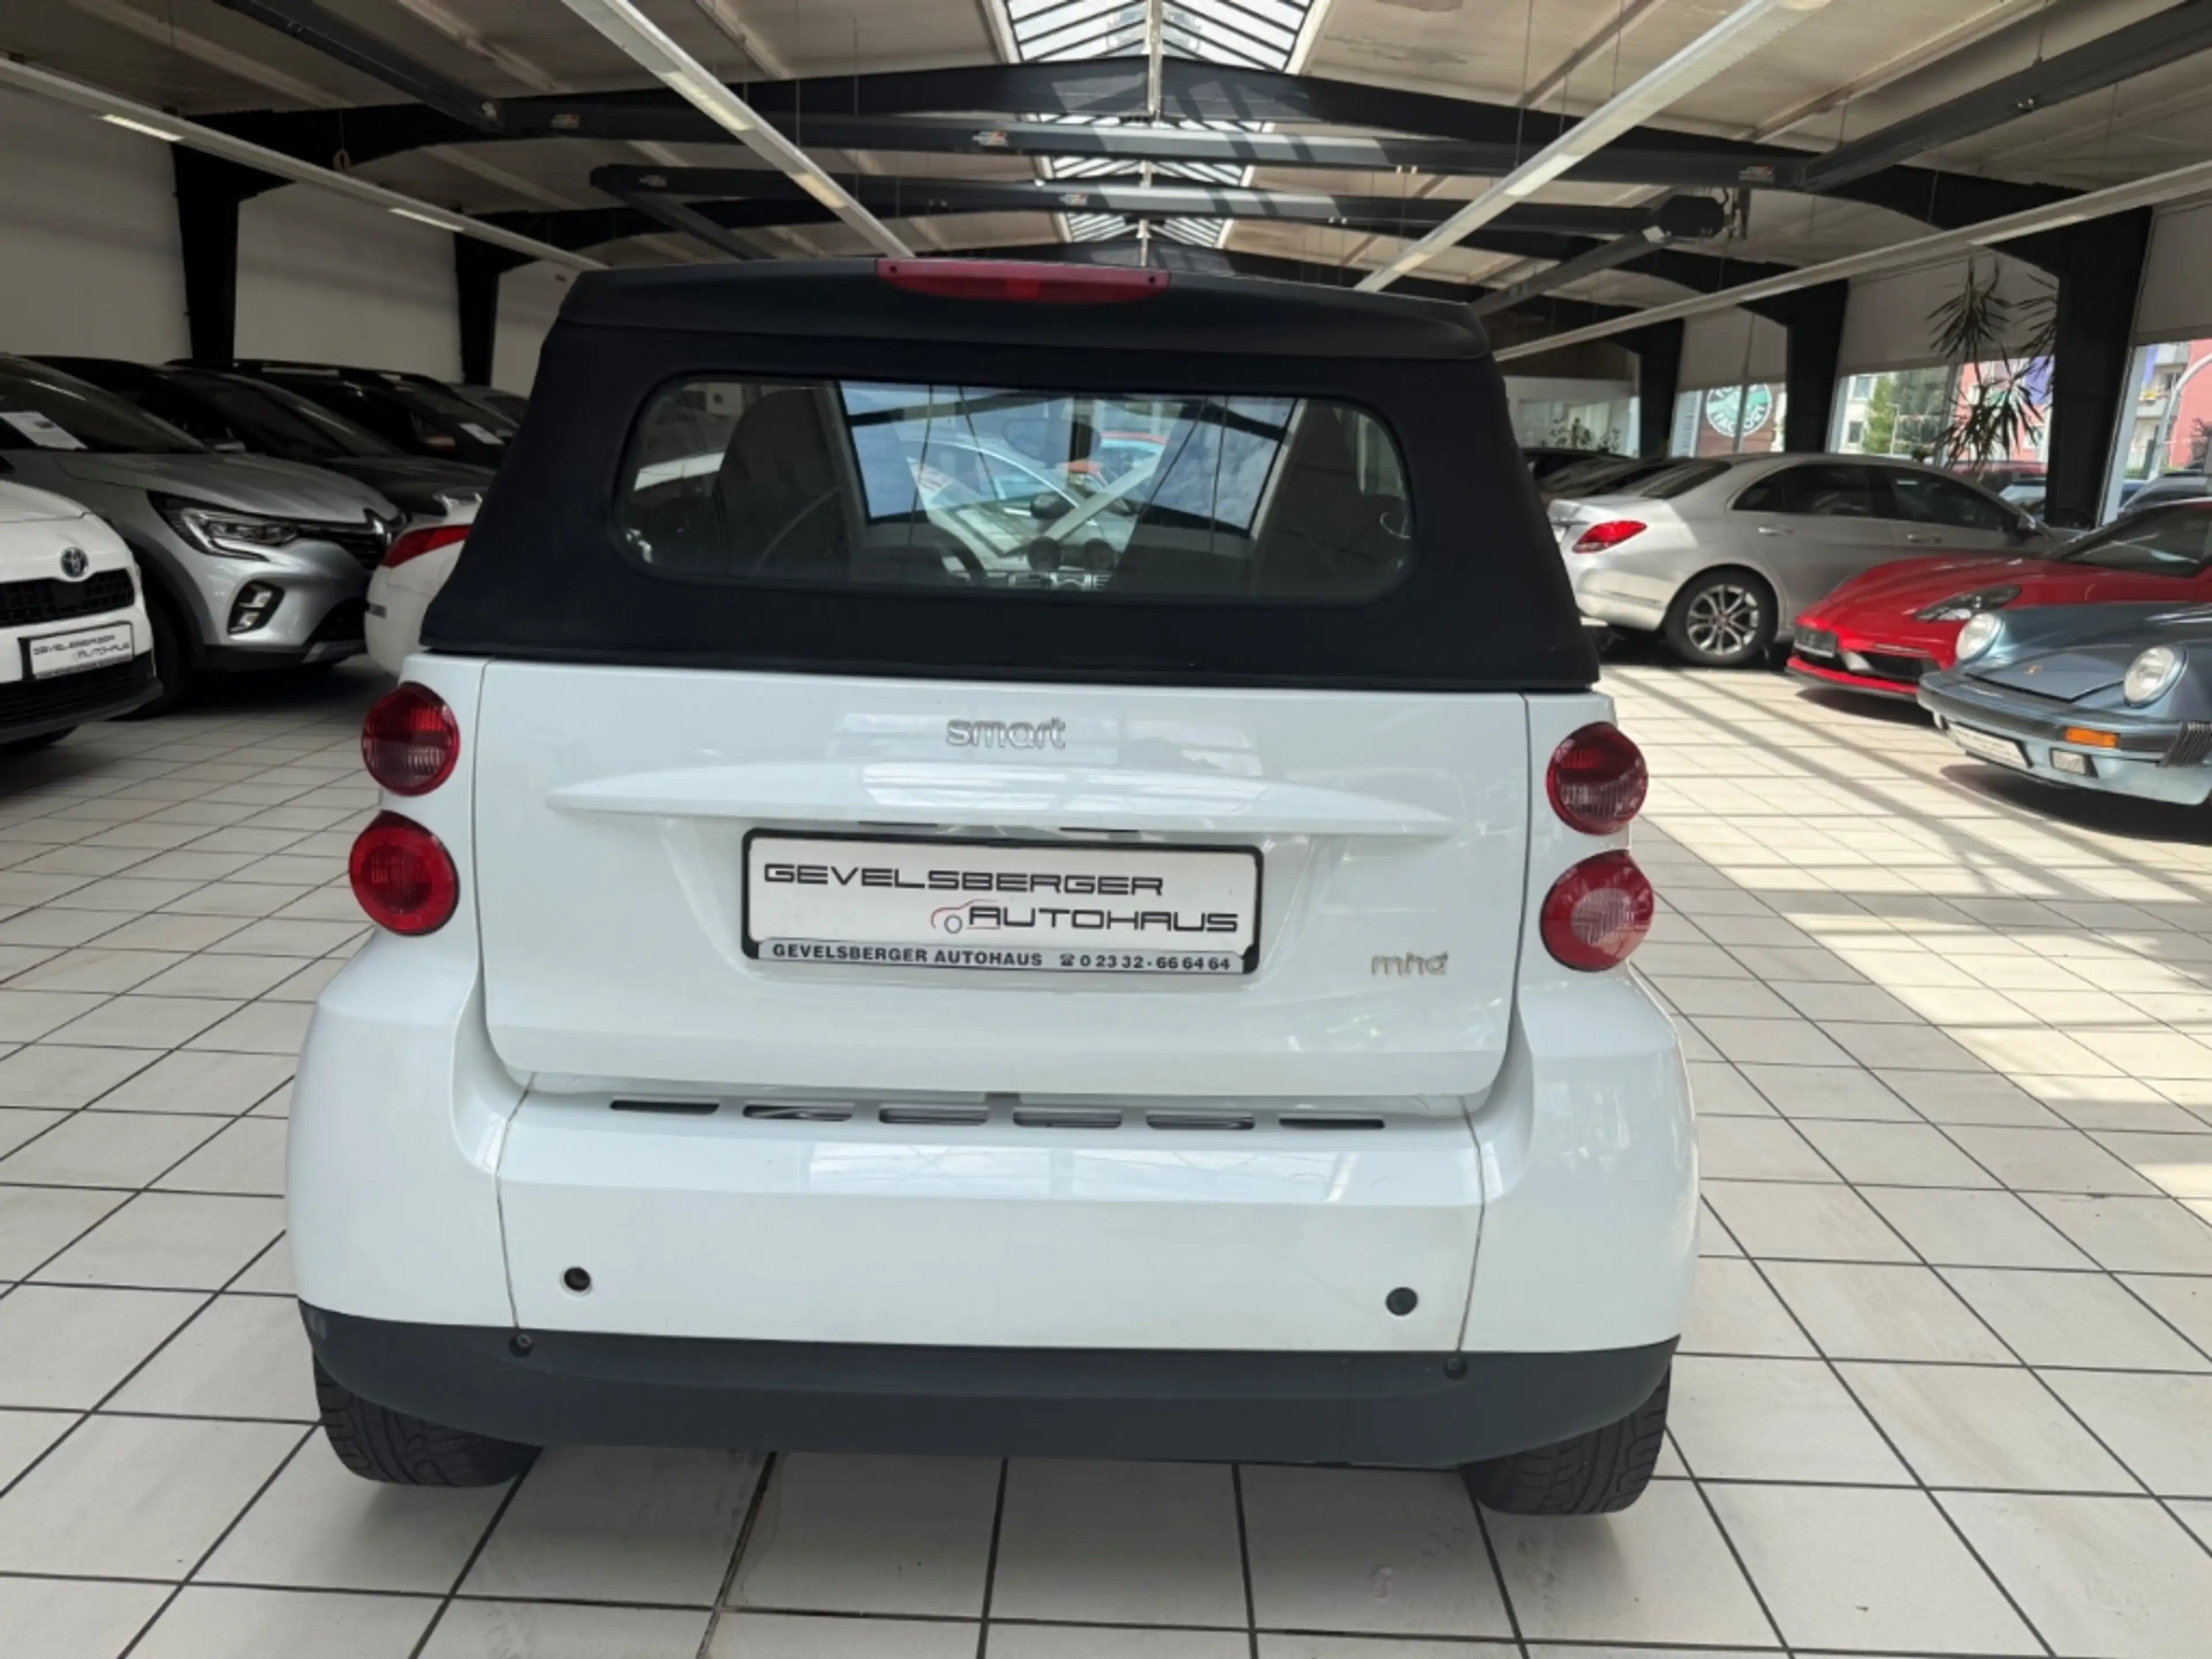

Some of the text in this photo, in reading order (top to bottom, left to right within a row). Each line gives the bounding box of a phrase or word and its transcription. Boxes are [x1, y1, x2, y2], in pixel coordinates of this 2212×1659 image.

[946, 717, 1066, 749] smart
[764, 863, 1164, 896] GEVELSBERGER
[969, 906, 1238, 933] AUTOHAUS
[772, 943, 928, 963] GEVELSBERGER
[934, 949, 1043, 967] AUTOHAUS
[1371, 952, 1448, 976] mhd
